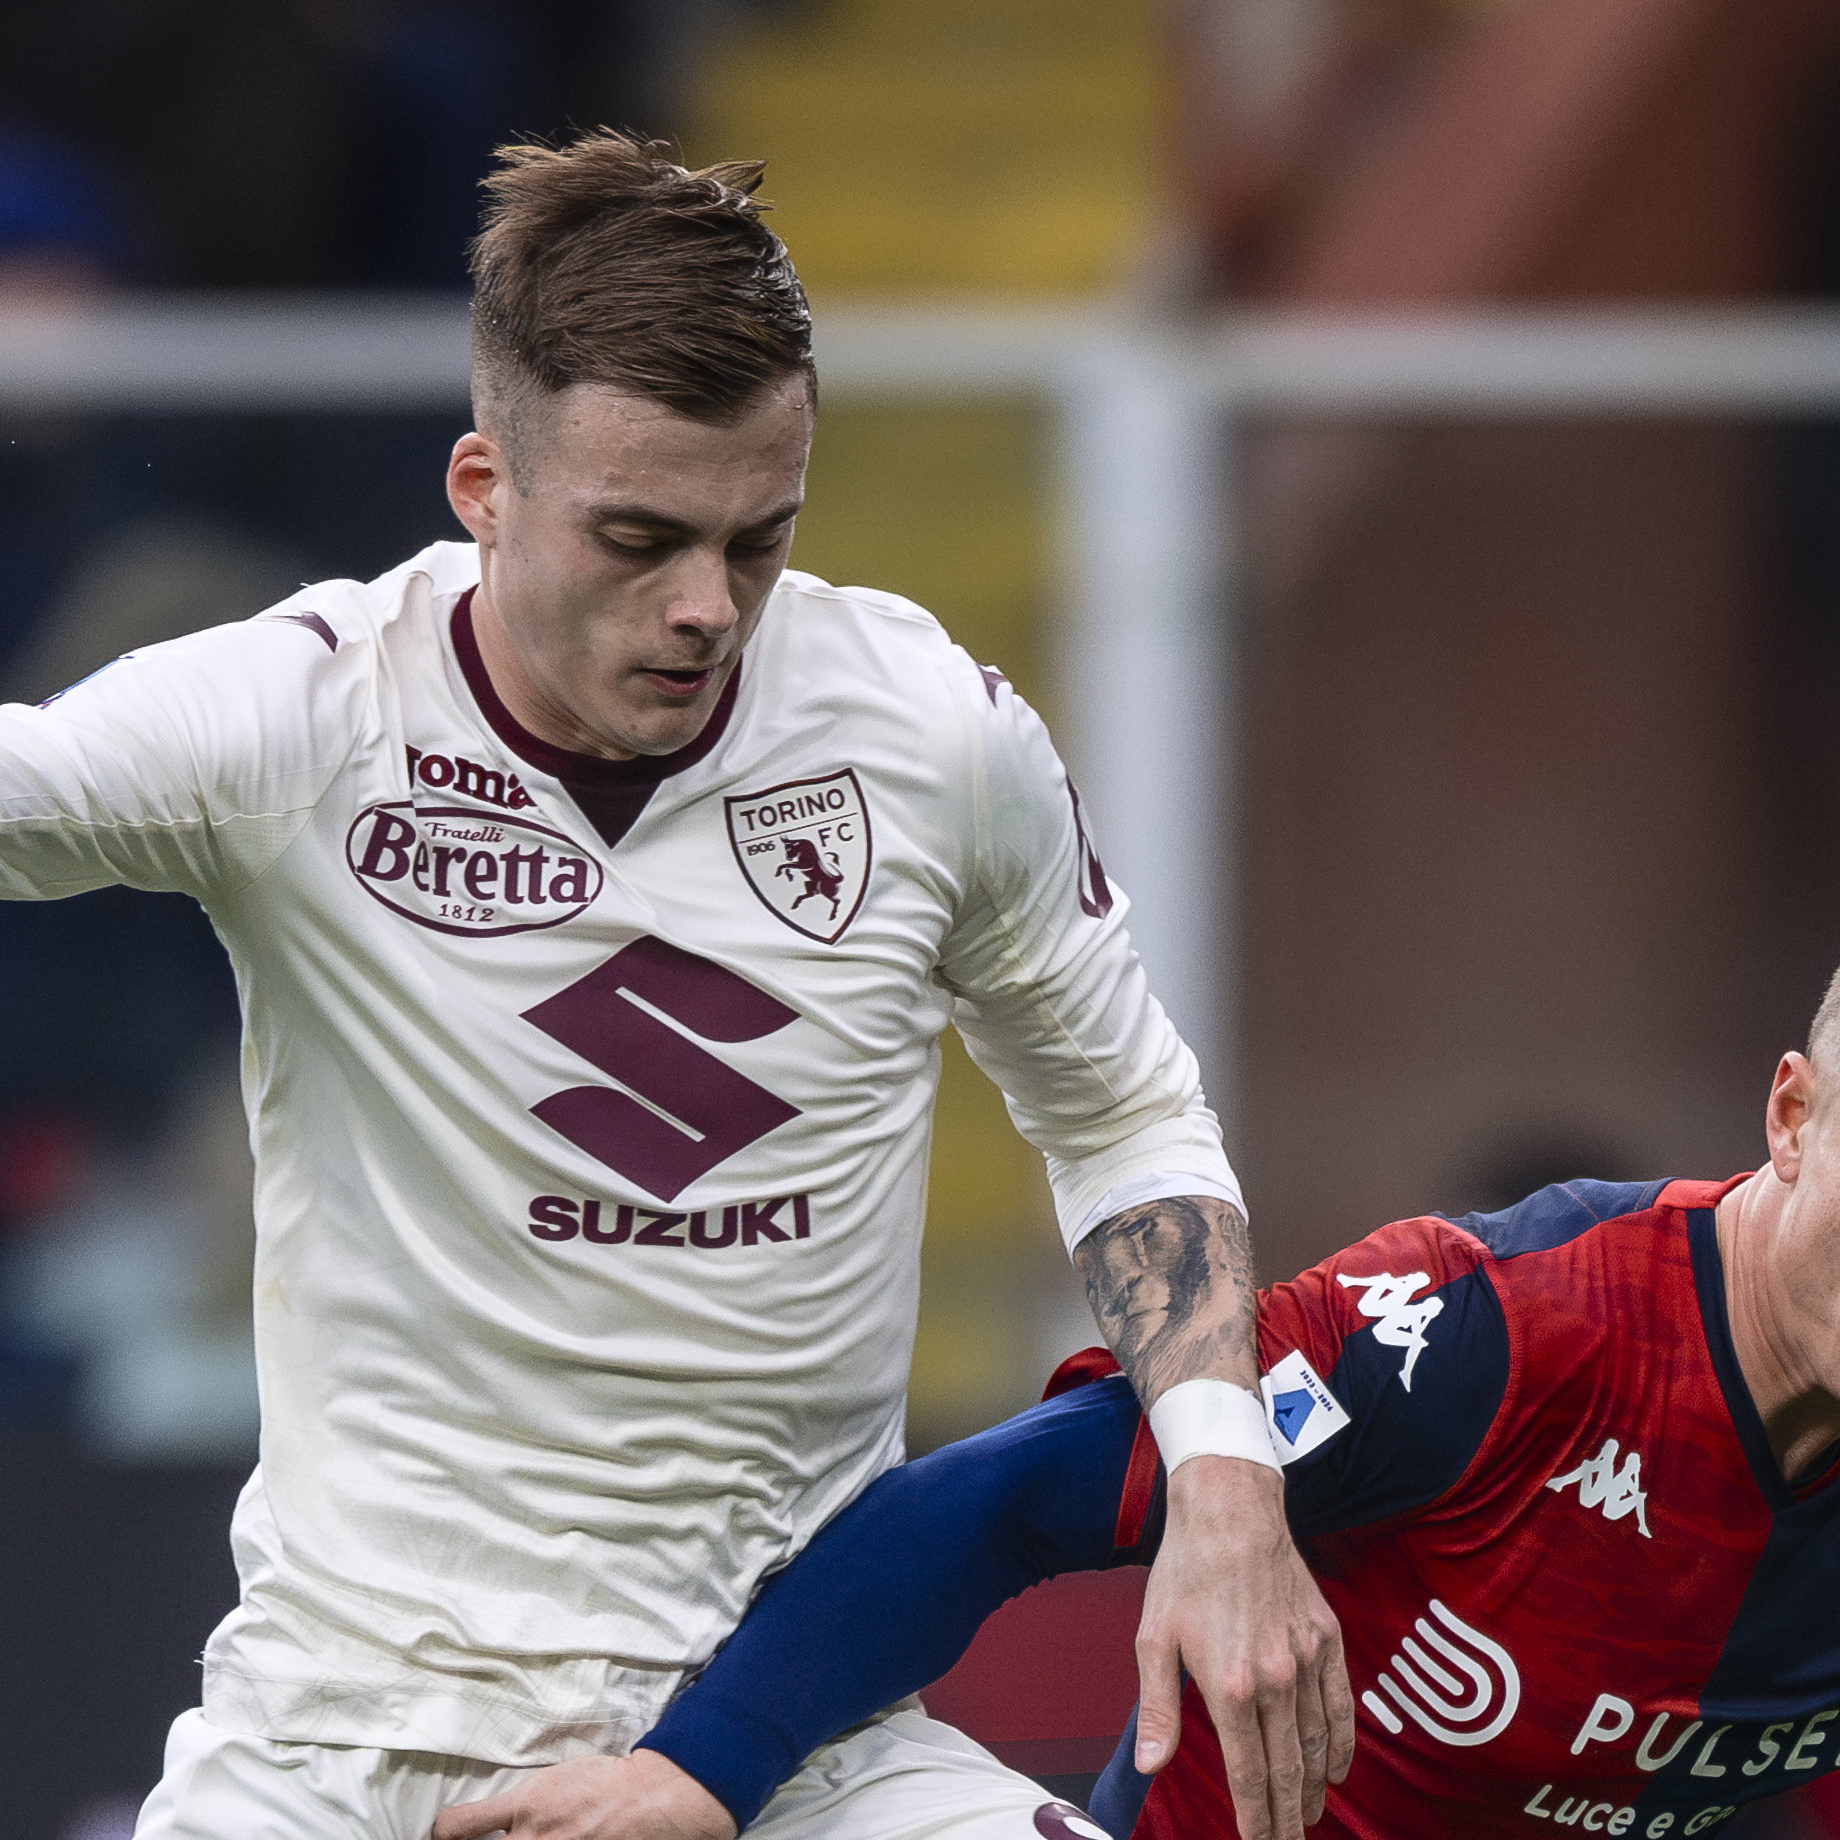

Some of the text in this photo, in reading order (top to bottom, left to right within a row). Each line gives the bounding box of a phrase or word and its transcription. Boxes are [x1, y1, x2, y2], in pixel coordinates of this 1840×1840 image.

[739, 788, 846, 832] TORINO
[424, 822, 505, 844] Fratelli
[746, 841, 777, 857] 1906
[355, 808, 591, 905] Beretta
[438, 903, 495, 923] 1812
[528, 1194, 811, 1249] SUZUKI
[1524, 1784, 1636, 1836] Luce
[1646, 1812, 1674, 1839] e
